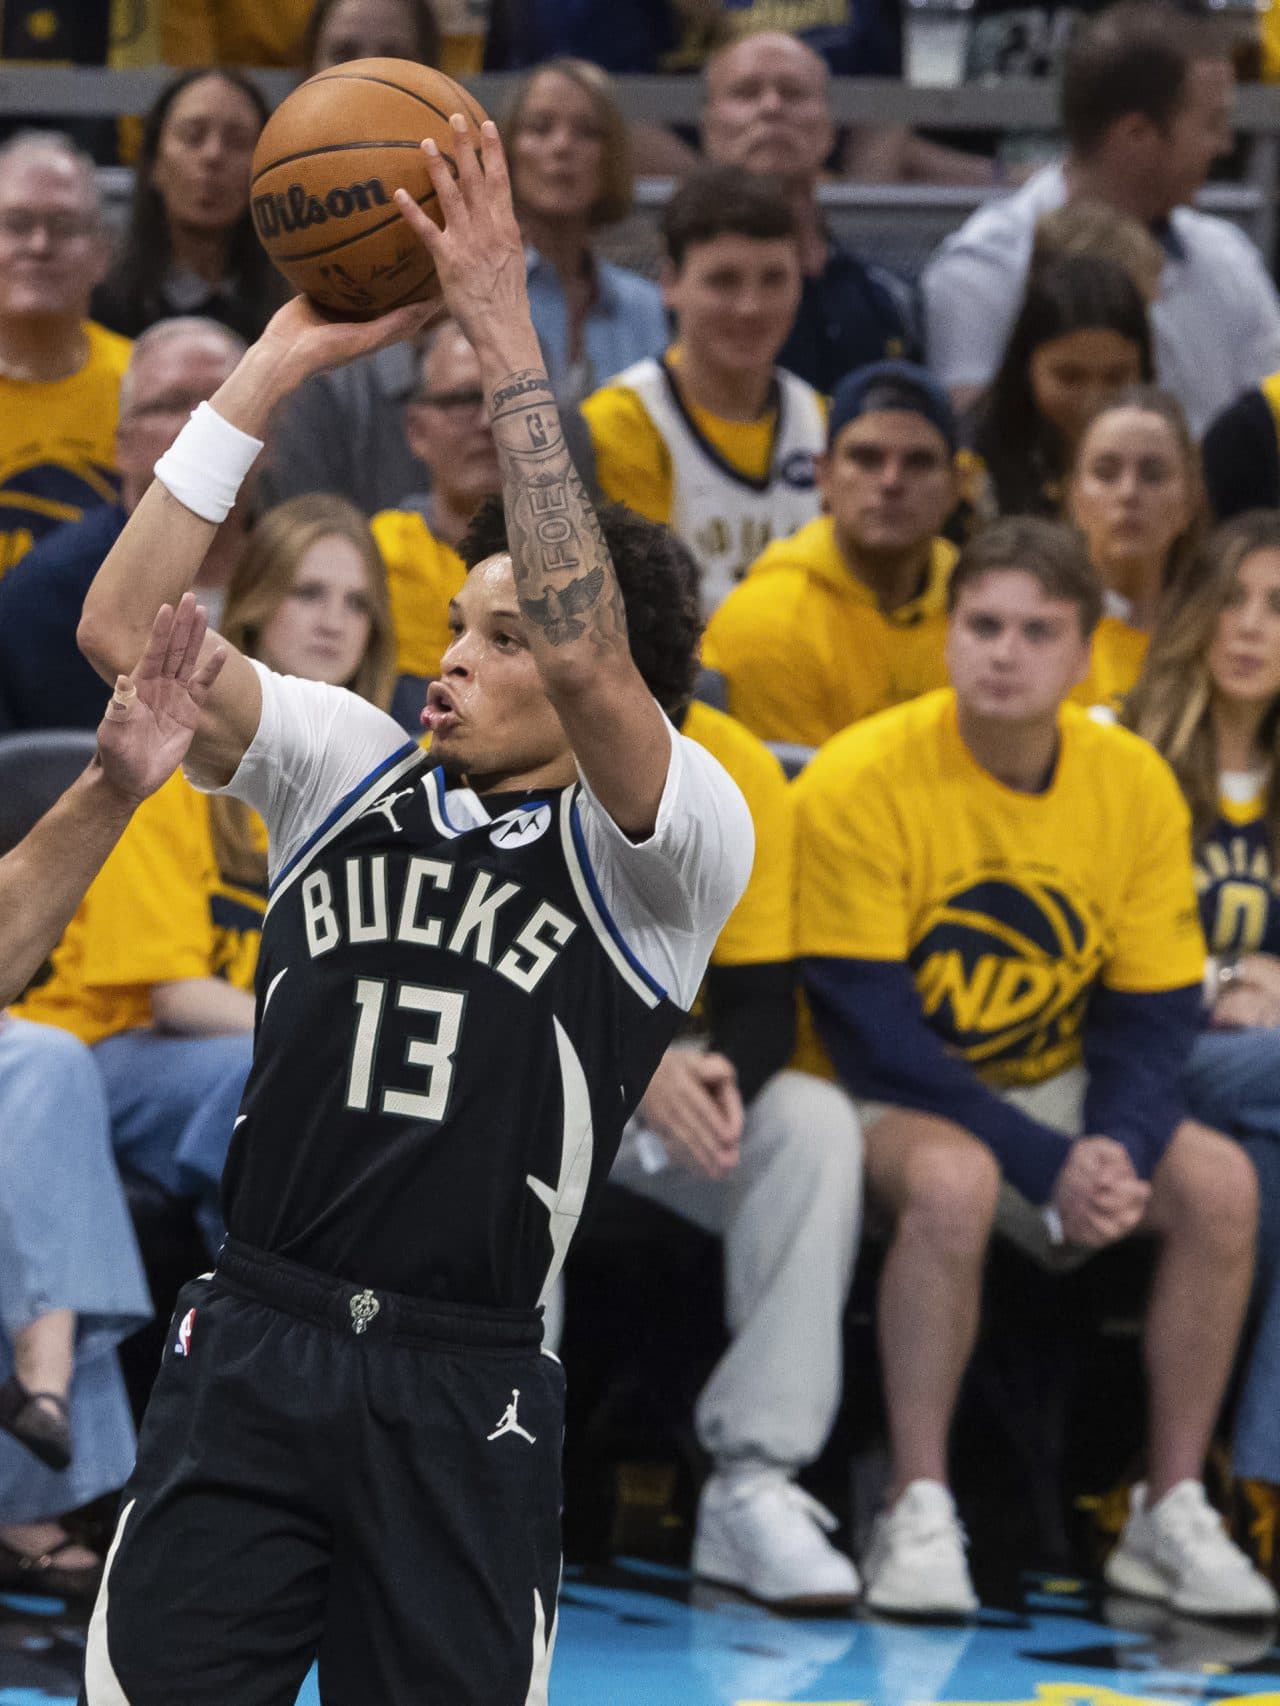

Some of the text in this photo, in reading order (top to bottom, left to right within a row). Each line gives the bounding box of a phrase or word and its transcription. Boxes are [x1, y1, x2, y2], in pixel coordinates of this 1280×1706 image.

[253, 178, 392, 238] Wilson
[301, 853, 578, 995] BUCKS
[343, 974, 469, 1124] 13
